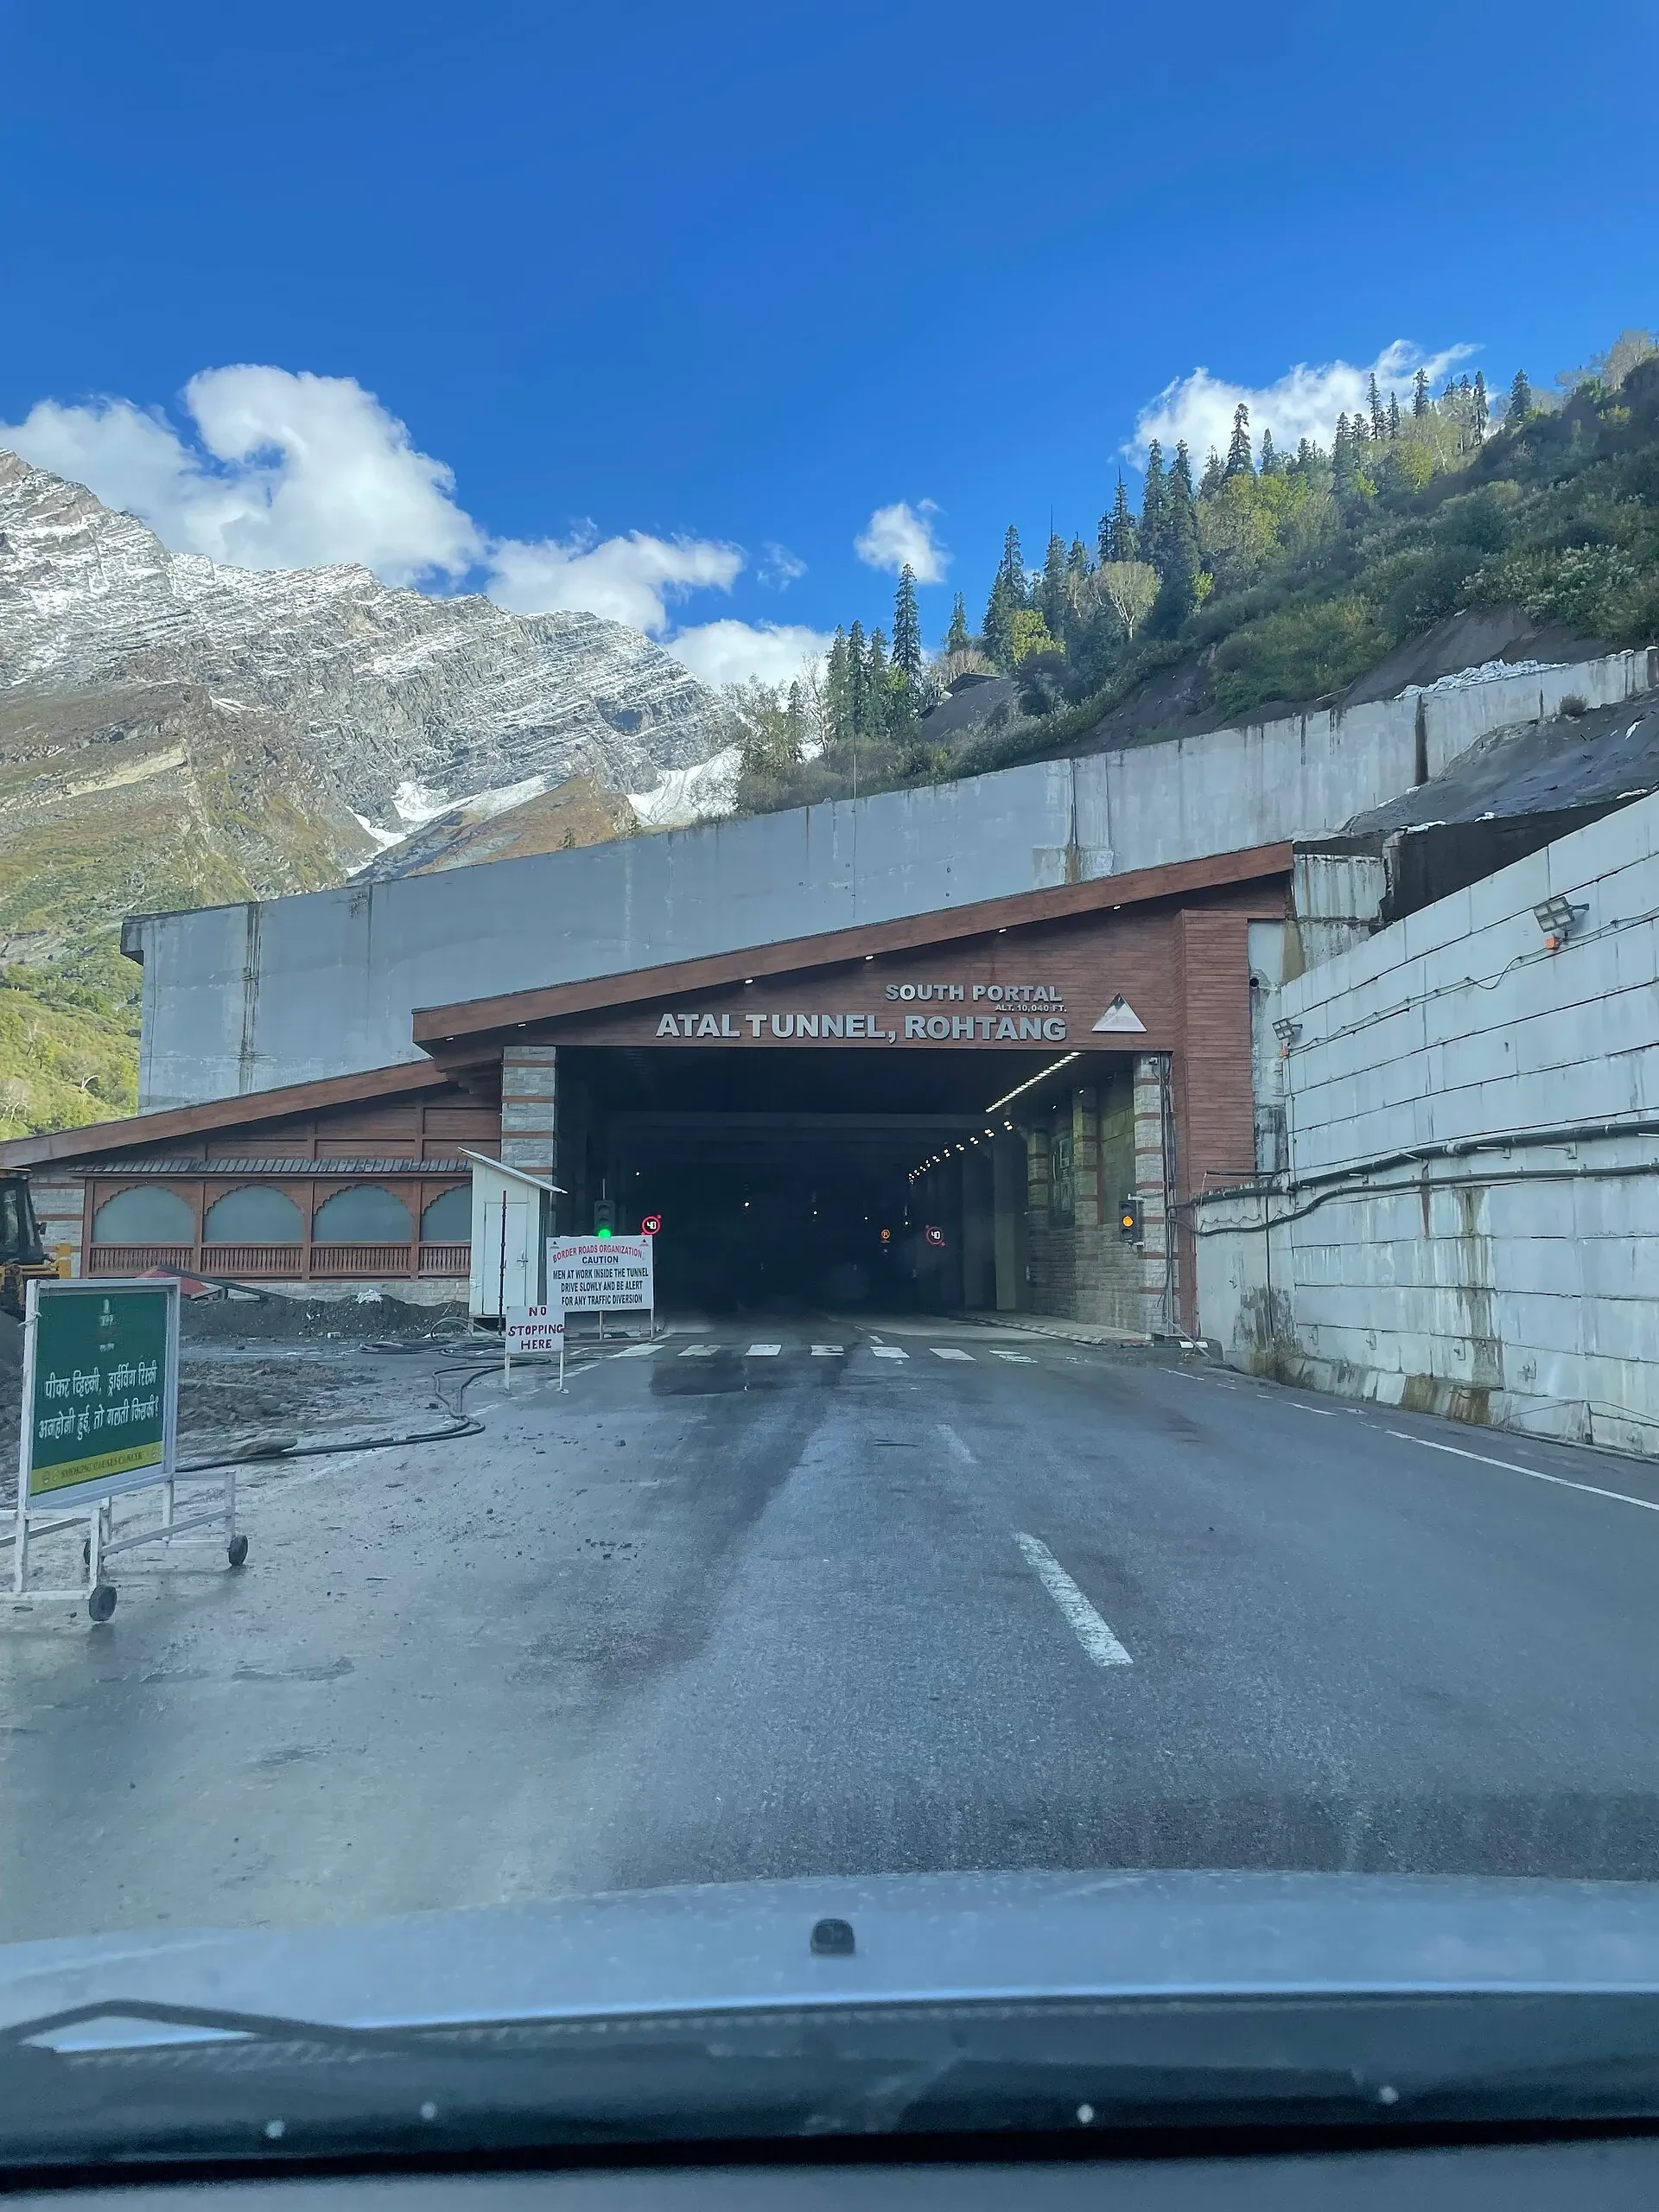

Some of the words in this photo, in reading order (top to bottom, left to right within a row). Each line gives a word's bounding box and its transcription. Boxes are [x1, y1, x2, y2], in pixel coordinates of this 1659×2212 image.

[885, 984, 964, 1001] SOUTH
[972, 985, 1063, 1001] PORTAL
[1017, 1004, 1049, 1013] 10,040
[656, 1014, 741, 1037] ATAL
[745, 1014, 896, 1044] TUNNEL,
[905, 1015, 1066, 1041] ROHTANG
[647, 1221, 657, 1230] 40
[931, 1230, 941, 1240] 40
[553, 1248, 577, 1263] BORDER
[578, 1244, 598, 1256] ROADS
[599, 1244, 642, 1258] ORGANIZATION
[582, 1255, 619, 1264] CAUTION
[553, 1269, 566, 1279] MEN
[567, 1269, 575, 1279] AT
[575, 1268, 593, 1279] WORK
[594, 1268, 613, 1278] INSIDE
[614, 1268, 626, 1277] THE
[626, 1268, 649, 1277] TUNNEL
[561, 1282, 578, 1293] DRIVE
[579, 1281, 602, 1292] SLOWLY
[603, 1281, 615, 1291] AND
[616, 1281, 624, 1290] BE
[625, 1281, 643, 1290] ALERT
[562, 1296, 573, 1306] FOR
[574, 1296, 586, 1306] ANY
[588, 1295, 611, 1305] TRAFFIC
[612, 1294, 643, 1304] DIVERSION
[529, 1306, 547, 1316] NO
[508, 1324, 564, 1337] STOPPING
[521, 1339, 552, 1350] HERE
[46, 1372, 70, 1398] पीकर
[138, 1359, 157, 1386] रिस्की
[39, 1407, 76, 1440] अनहोनी
[93, 1403, 105, 1430] तो
[106, 1398, 130, 1426] गलती
